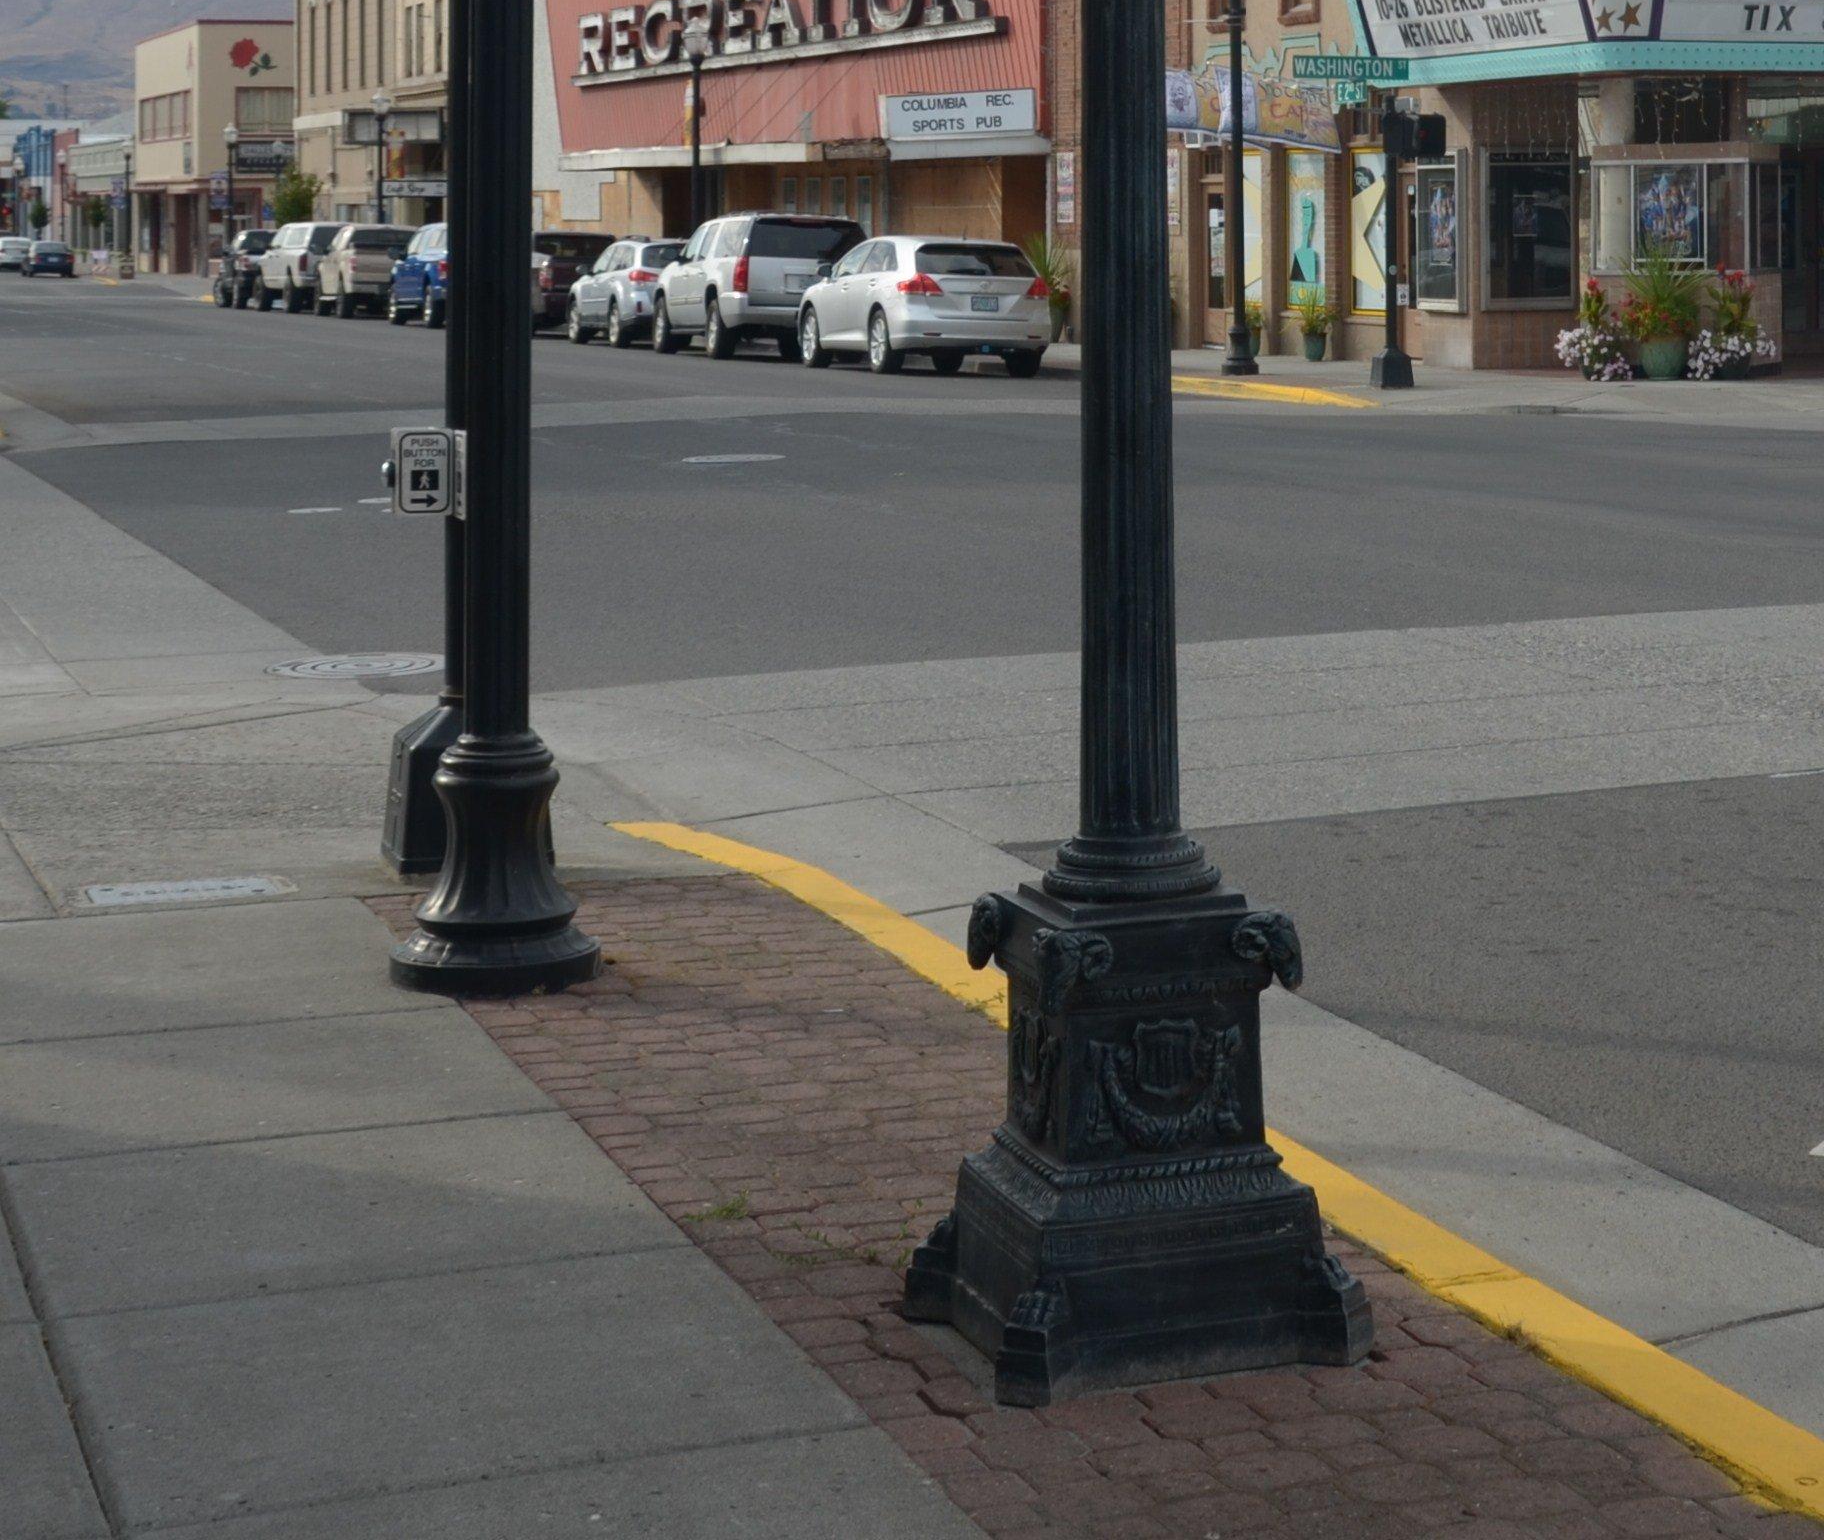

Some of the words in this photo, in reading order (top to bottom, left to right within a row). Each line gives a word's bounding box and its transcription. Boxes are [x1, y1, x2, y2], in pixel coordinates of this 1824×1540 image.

[1743, 5, 1797, 32] TIX
[1397, 17, 1474, 48] METALLICA
[1482, 9, 1548, 40] TRIBUTE
[1294, 57, 1393, 77] WASHINGTON
[1397, 61, 1407, 70] ST
[1337, 83, 1343, 100] E
[1355, 81, 1364, 100] ST
[901, 96, 968, 112] COLUMBIA
[985, 93, 1015, 107] REC.
[912, 117, 965, 133] SPORTS
[976, 116, 1002, 129] PUB
[410, 438, 440, 447] PUSH
[403, 448, 447, 458] BUTTON
[414, 459, 436, 468] FOR
